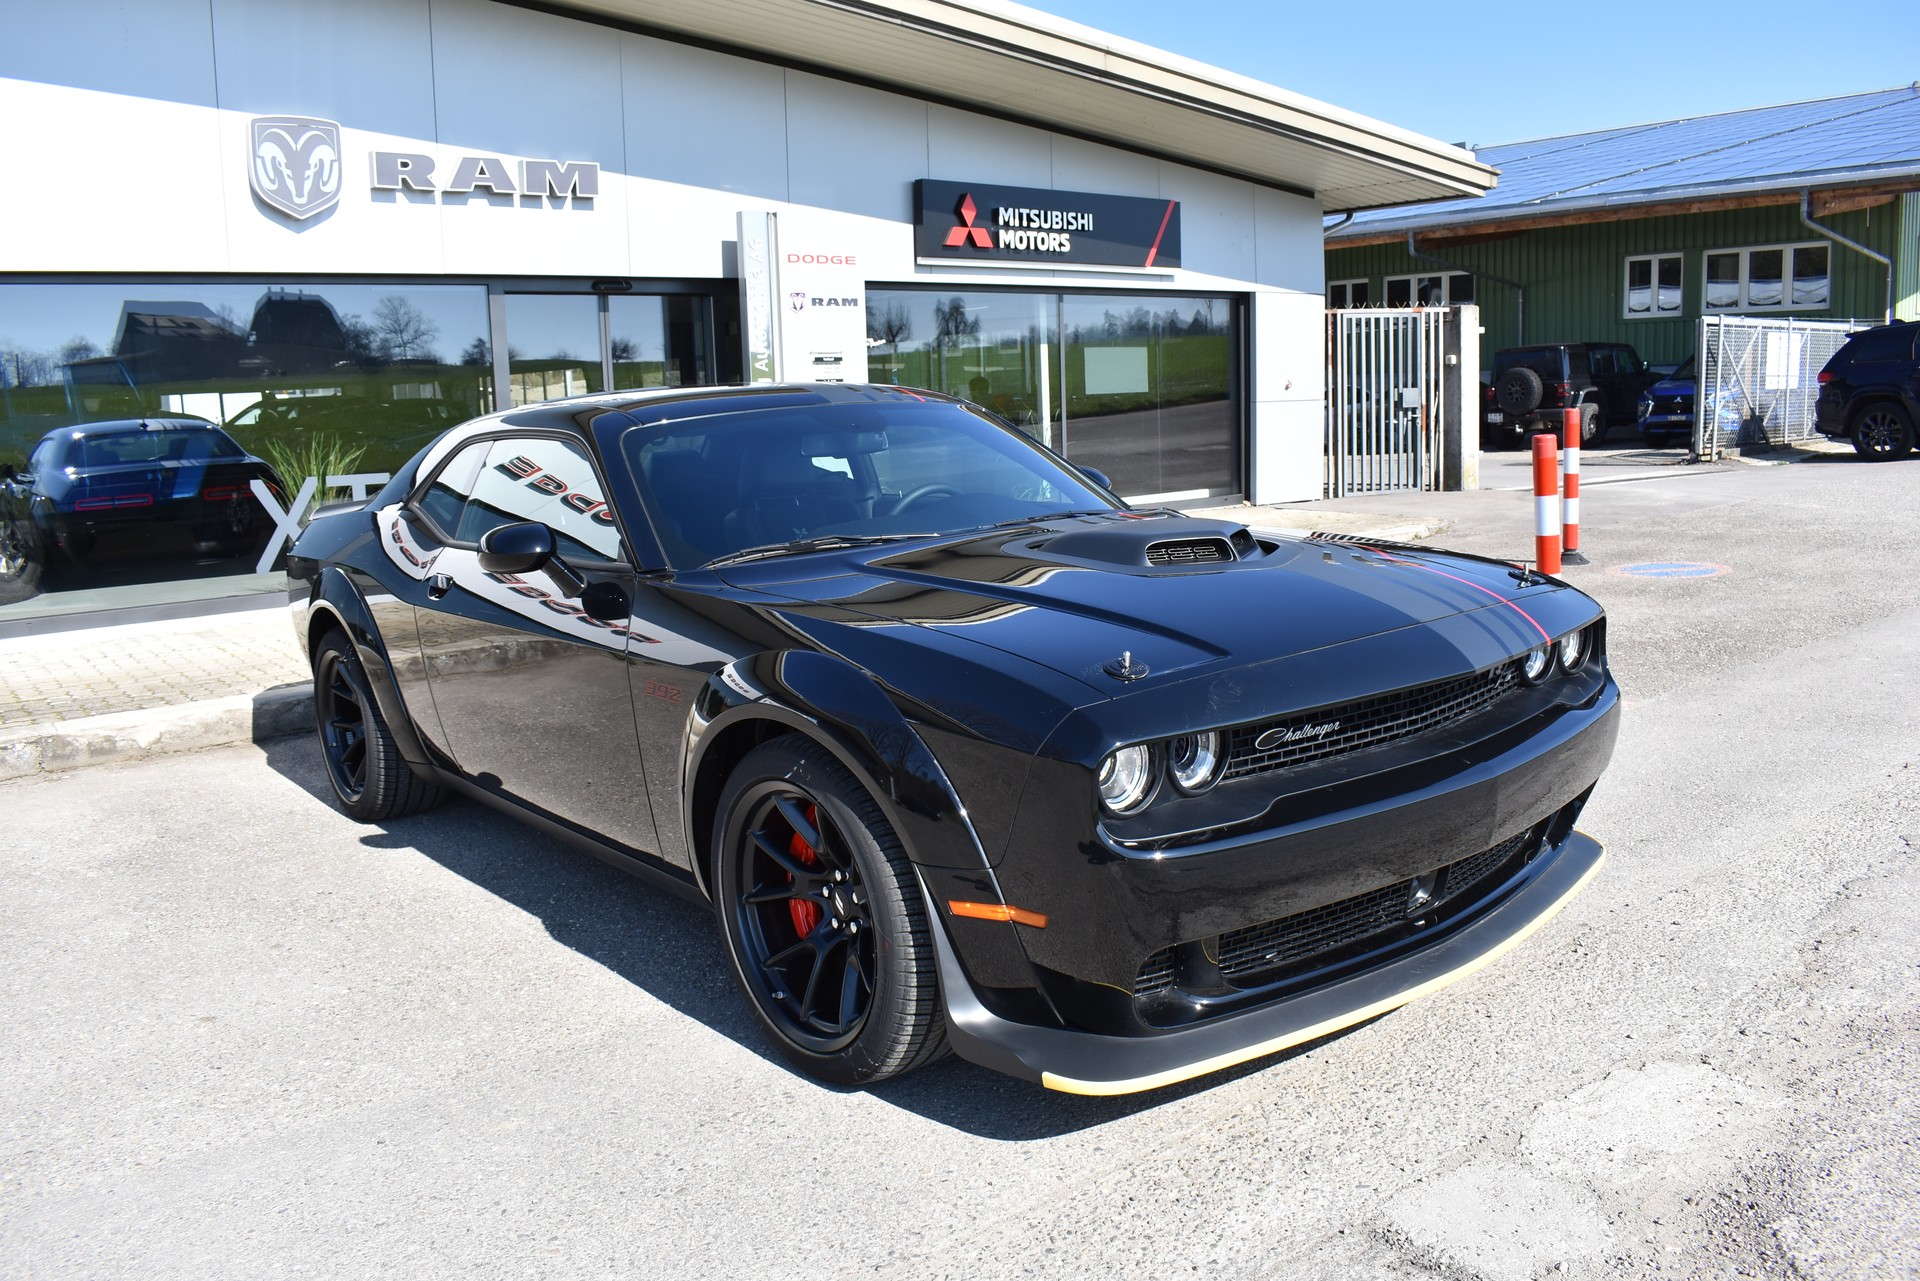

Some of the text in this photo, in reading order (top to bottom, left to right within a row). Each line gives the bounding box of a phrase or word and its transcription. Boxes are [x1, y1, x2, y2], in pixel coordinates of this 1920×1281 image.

[367, 150, 600, 198] RAM
[998, 206, 1093, 231] MITSUBISHI
[998, 229, 1071, 252] MOTORS
[787, 253, 857, 265] DODGE
[811, 297, 859, 307] RAM
[643, 680, 682, 703] 392
[1255, 721, 1340, 750] Challenger
